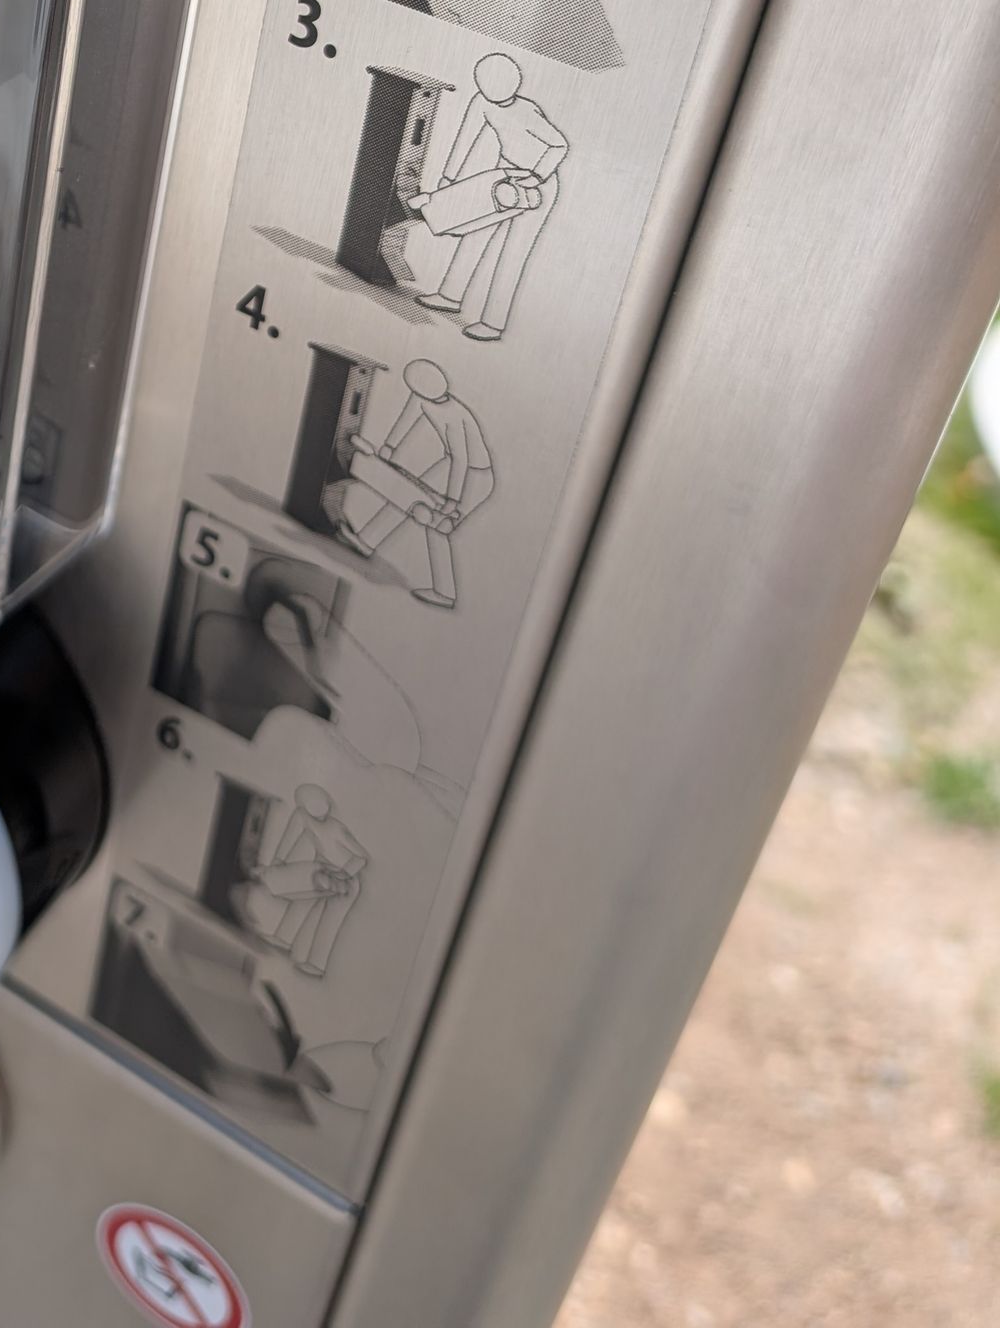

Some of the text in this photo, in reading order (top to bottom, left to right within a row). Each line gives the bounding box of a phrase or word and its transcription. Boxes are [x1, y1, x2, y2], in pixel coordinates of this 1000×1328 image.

[235, 285, 280, 339] 4.
[190, 528, 231, 579] 5.
[155, 715, 192, 761] 6.
[124, 893, 156, 941] 7.
